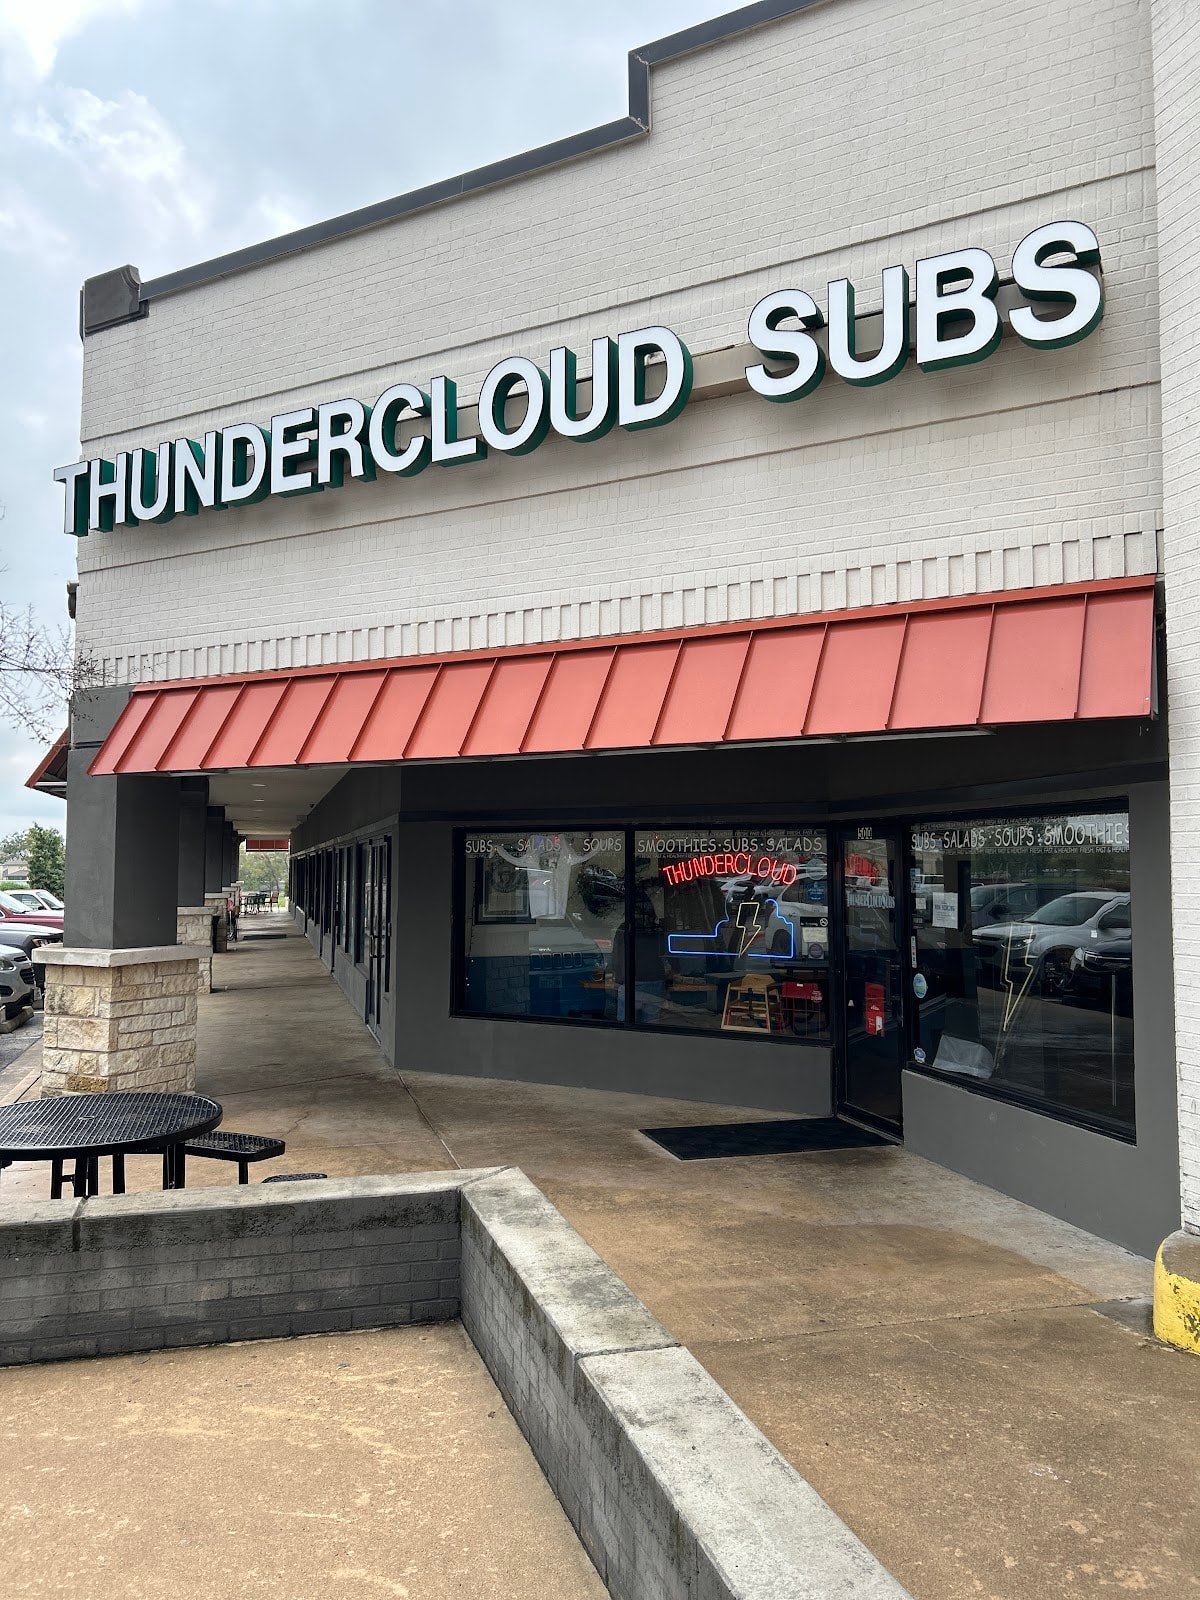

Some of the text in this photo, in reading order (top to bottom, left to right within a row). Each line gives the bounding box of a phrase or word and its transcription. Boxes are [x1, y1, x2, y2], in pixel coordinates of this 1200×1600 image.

[53, 219, 1103, 536] THUNDERCLOUD SUBS
[465, 838, 622, 854] SUBS SALADS SOUPS
[637, 837, 823, 853] SMOOTHIES SUBS SALADS
[911, 831, 936, 850] SUBS
[943, 828, 985, 849] SALADS
[994, 825, 1035, 847] SOUPS
[662, 852, 797, 886] THUNDERCLOUD
